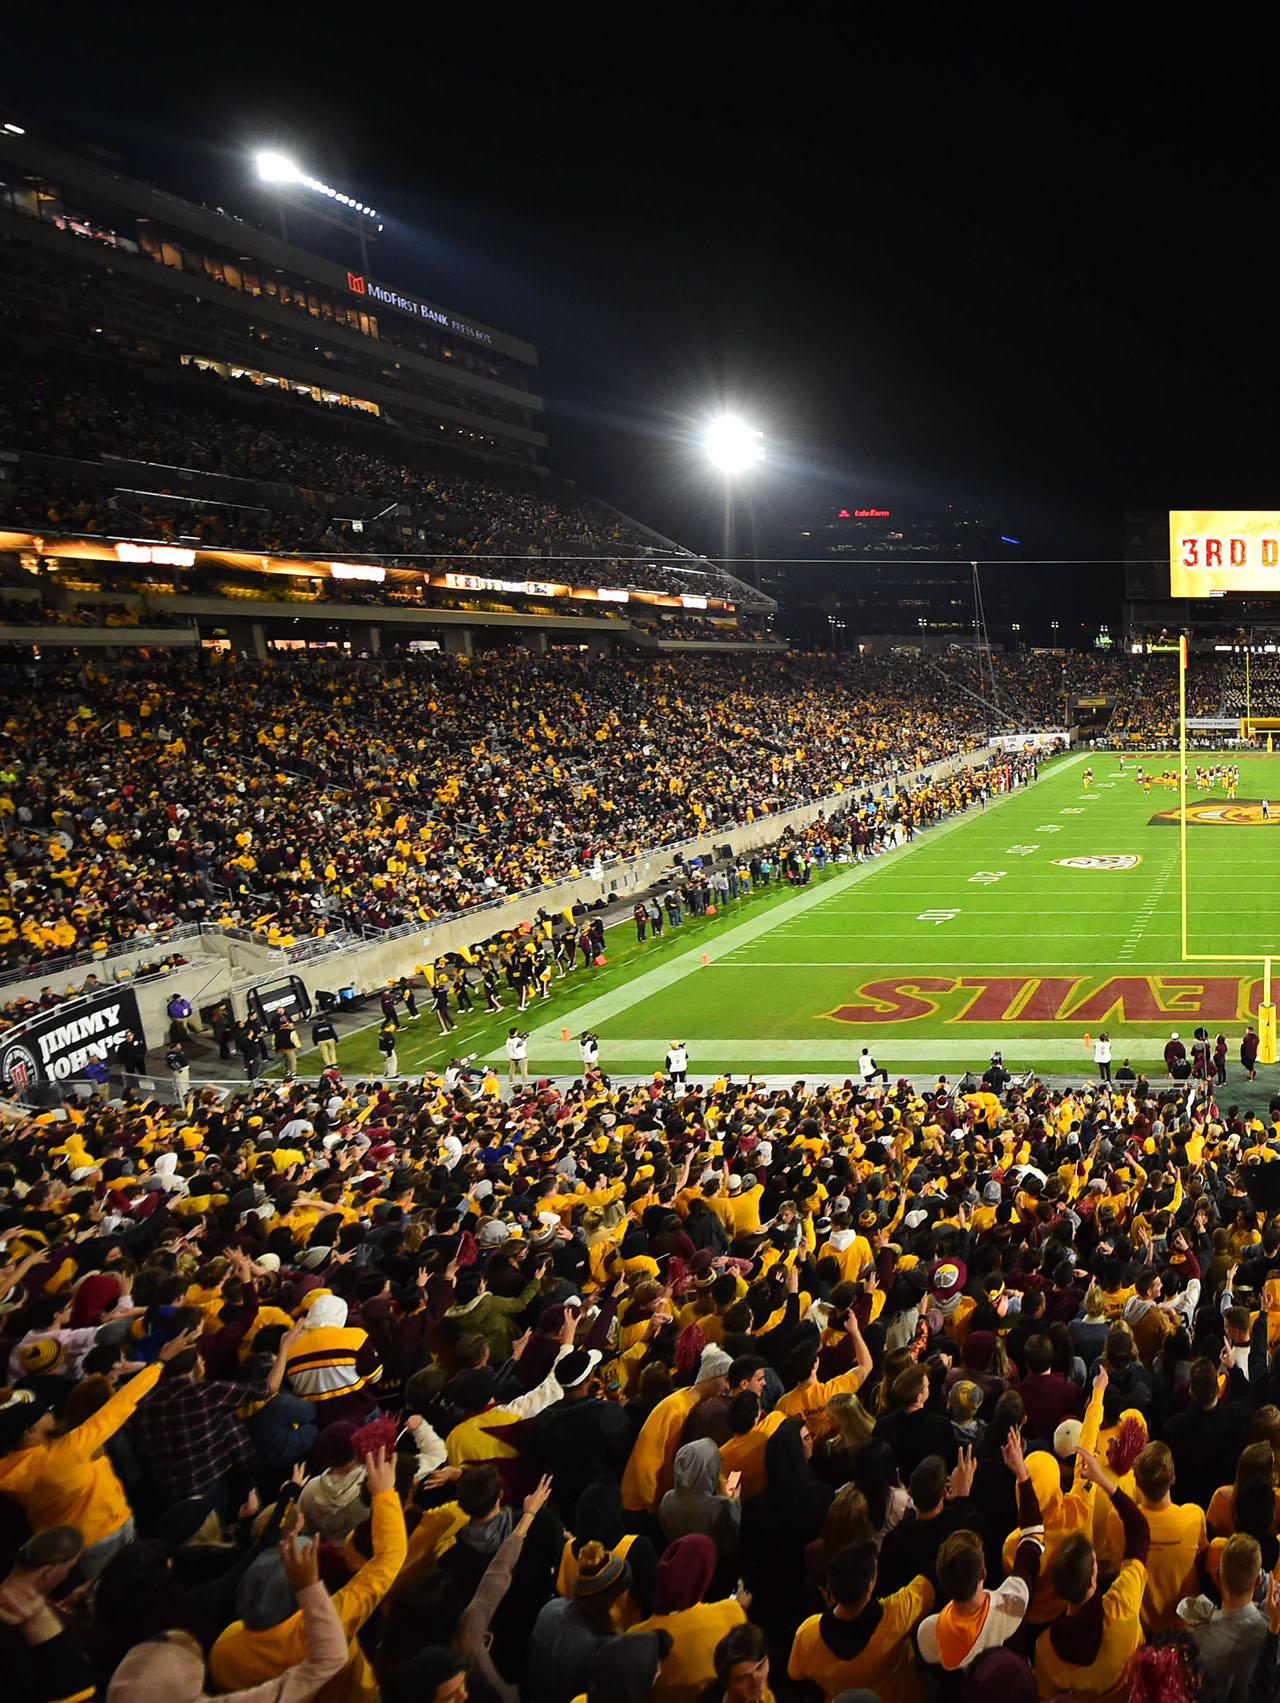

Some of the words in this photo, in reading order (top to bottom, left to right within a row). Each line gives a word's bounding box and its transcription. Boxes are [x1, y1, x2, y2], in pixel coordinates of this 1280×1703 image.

[420, 305, 449, 327] BANK
[451, 320, 476, 337] PRESS
[475, 330, 492, 344] BOX
[1182, 539, 1247, 567] 3RD
[37, 1003, 121, 1064] JIMMY
